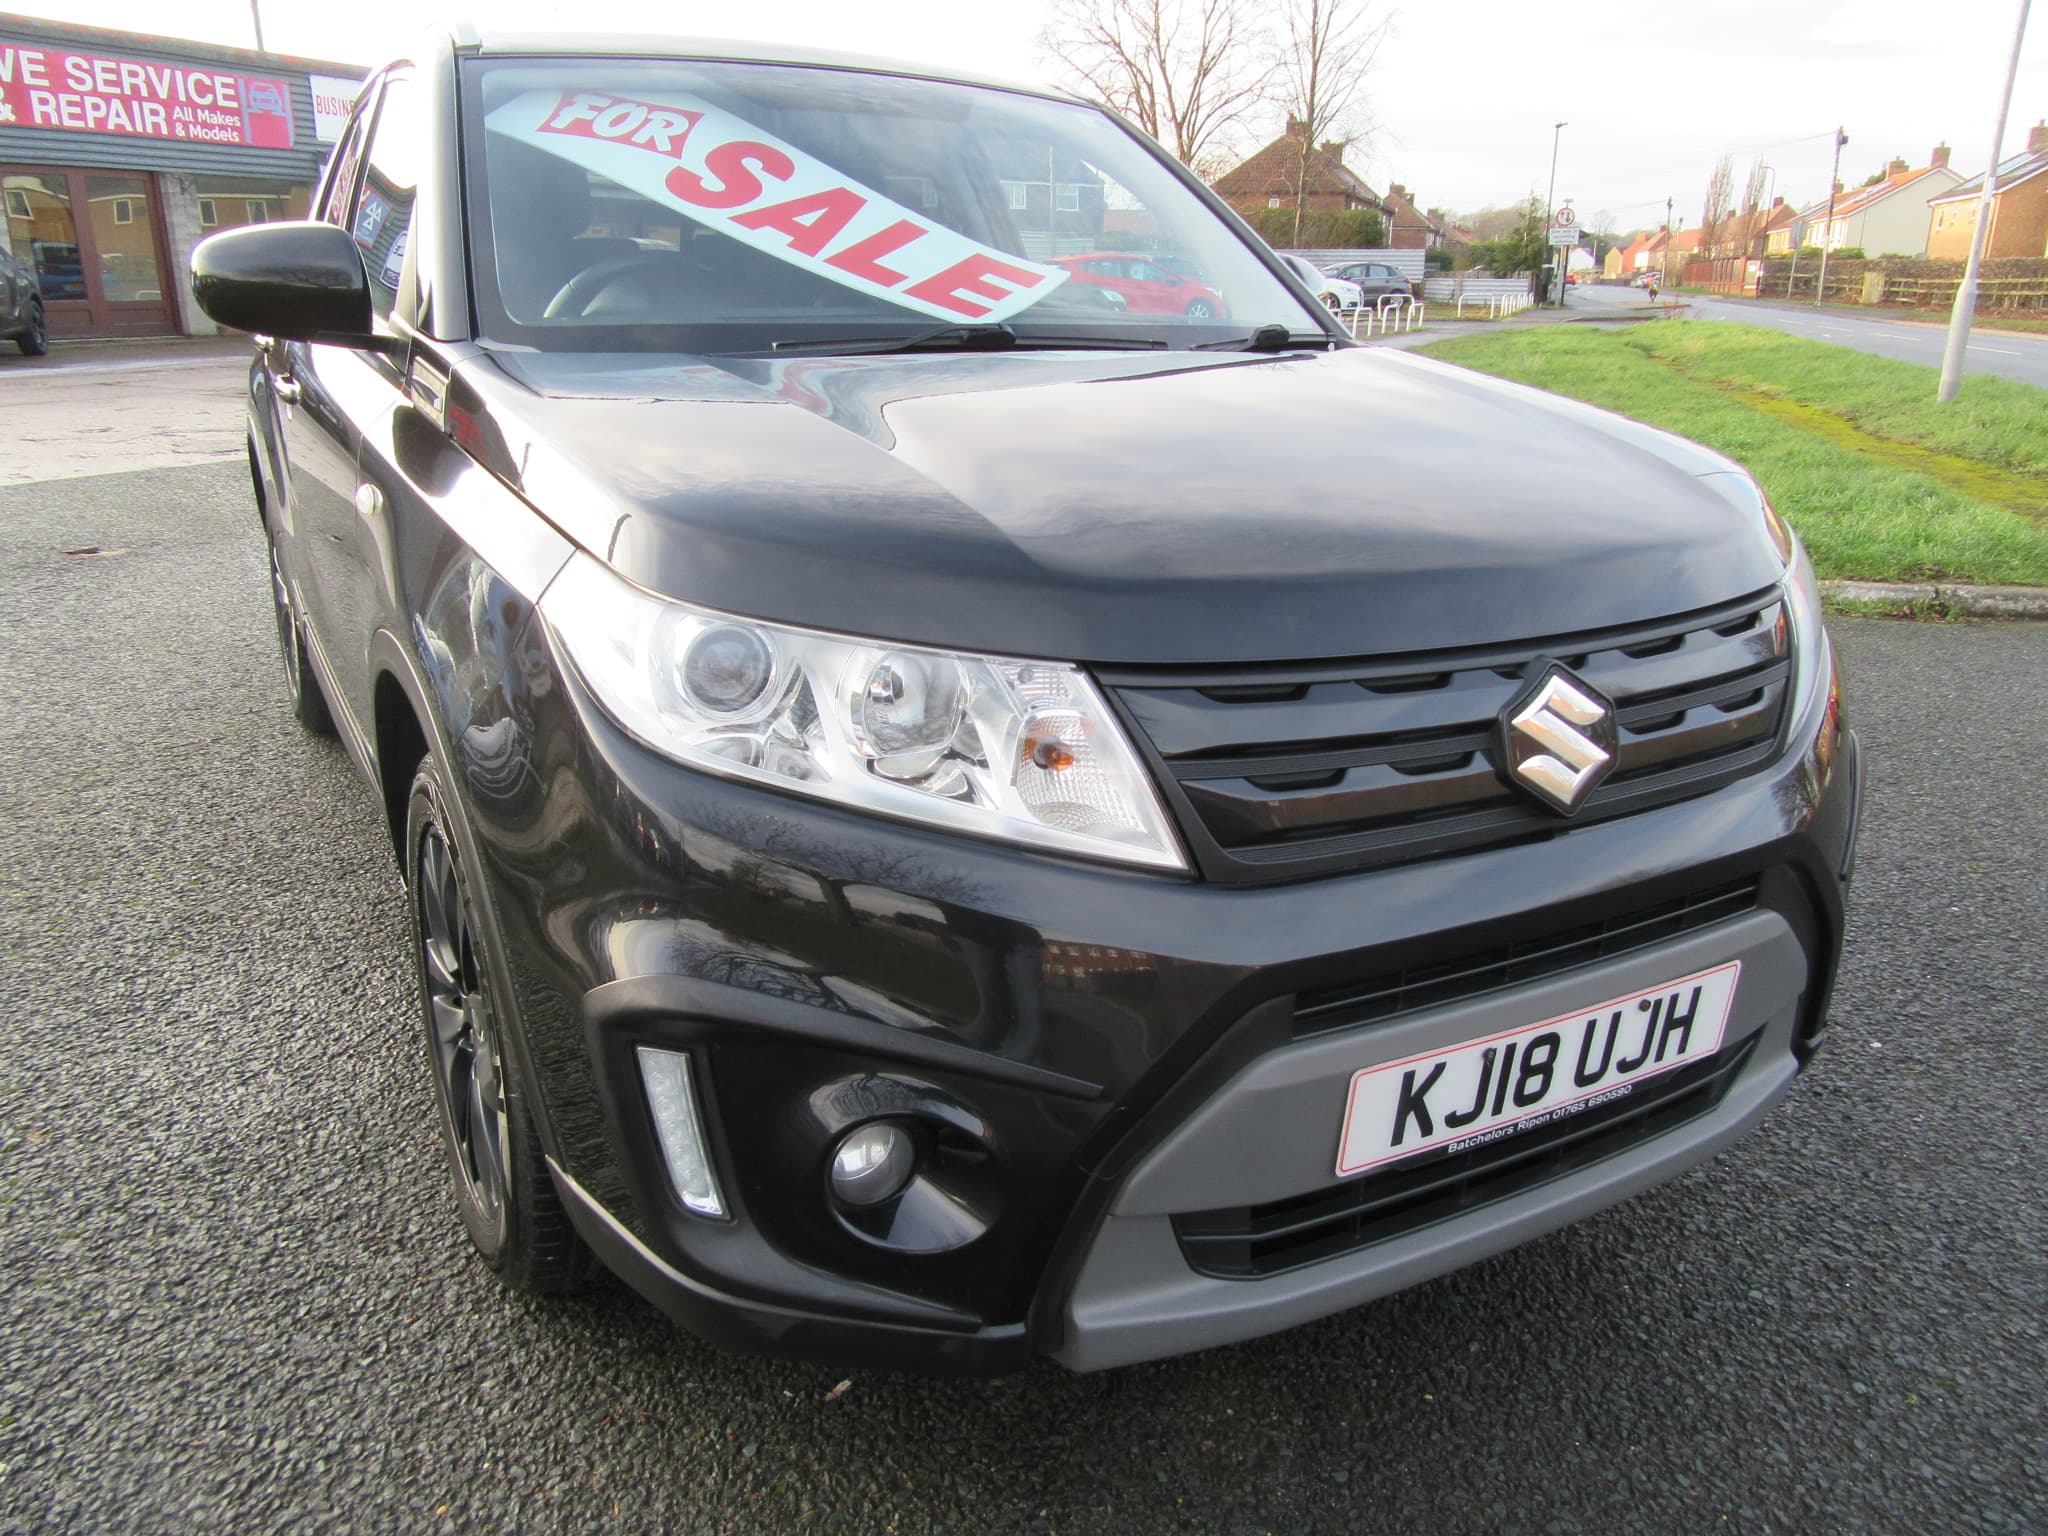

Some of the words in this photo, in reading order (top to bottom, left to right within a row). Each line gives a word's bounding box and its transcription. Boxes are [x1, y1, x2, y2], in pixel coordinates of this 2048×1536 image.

[64, 56, 239, 109] SERVICE
[29, 89, 168, 135] REPAIR
[173, 106, 193, 122] All
[197, 108, 241, 127] Makes
[175, 122, 185, 137] &
[188, 123, 240, 142] Models
[550, 92, 690, 153] FOR
[665, 141, 1046, 319] SALE
[1390, 1031, 1561, 1147] KJ18
[1573, 985, 1703, 1088] UJH
[1448, 1124, 1514, 1153] Batchelors
[1517, 1113, 1550, 1132] Ripon
[1552, 1101, 1586, 1120] 01765
[1588, 1085, 1632, 1107] 690590
